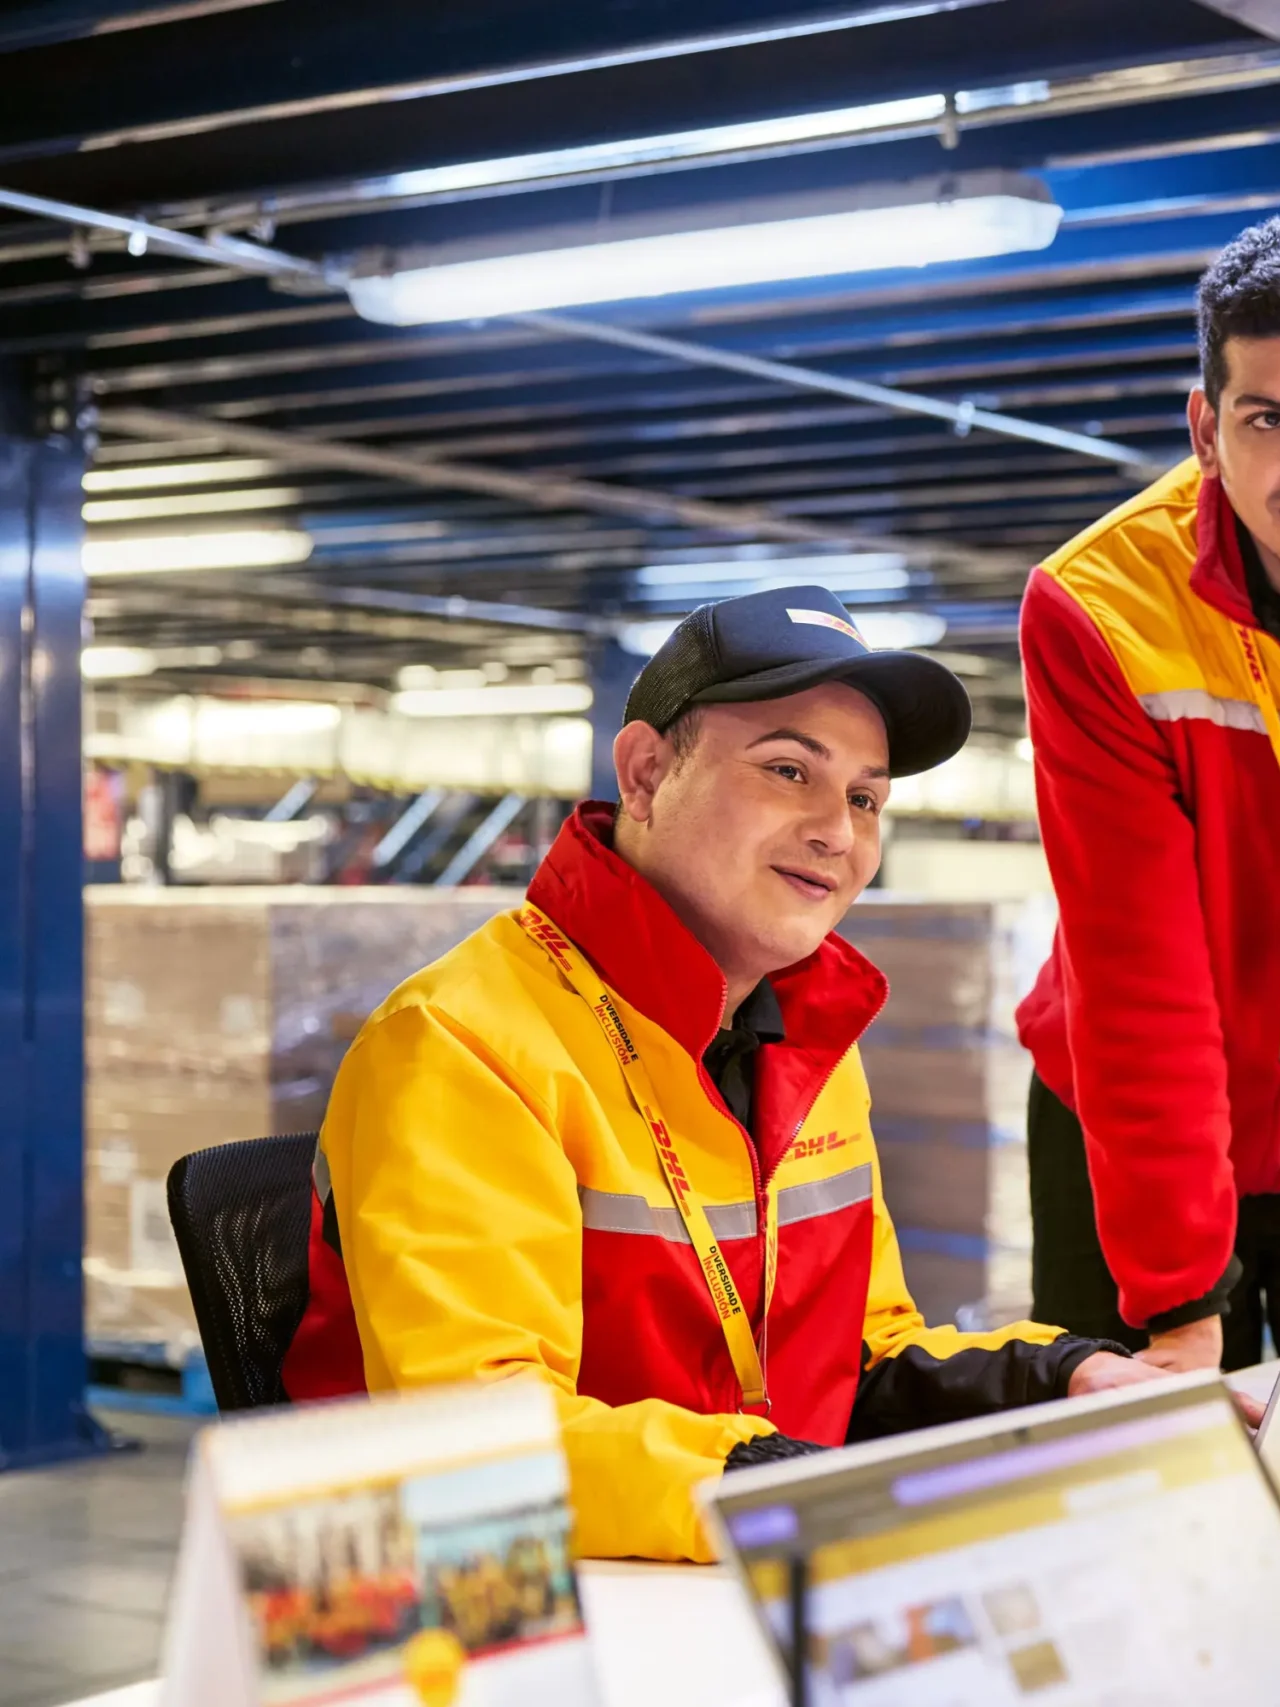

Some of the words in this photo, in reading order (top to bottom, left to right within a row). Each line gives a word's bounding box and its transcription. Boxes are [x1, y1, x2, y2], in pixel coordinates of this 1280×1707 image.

[520, 909, 571, 959] DHL
[594, 1003, 631, 1066] INCLUSIÓN
[599, 994, 634, 1053] DIVERSIDAD
[630, 1053, 639, 1062] E
[651, 1119, 691, 1205] DHL
[790, 1130, 846, 1160] DHL
[702, 1255, 731, 1320] INCLUSIÓN
[709, 1245, 738, 1308] DIVERSIDAD
[733, 1306, 741, 1315] E
